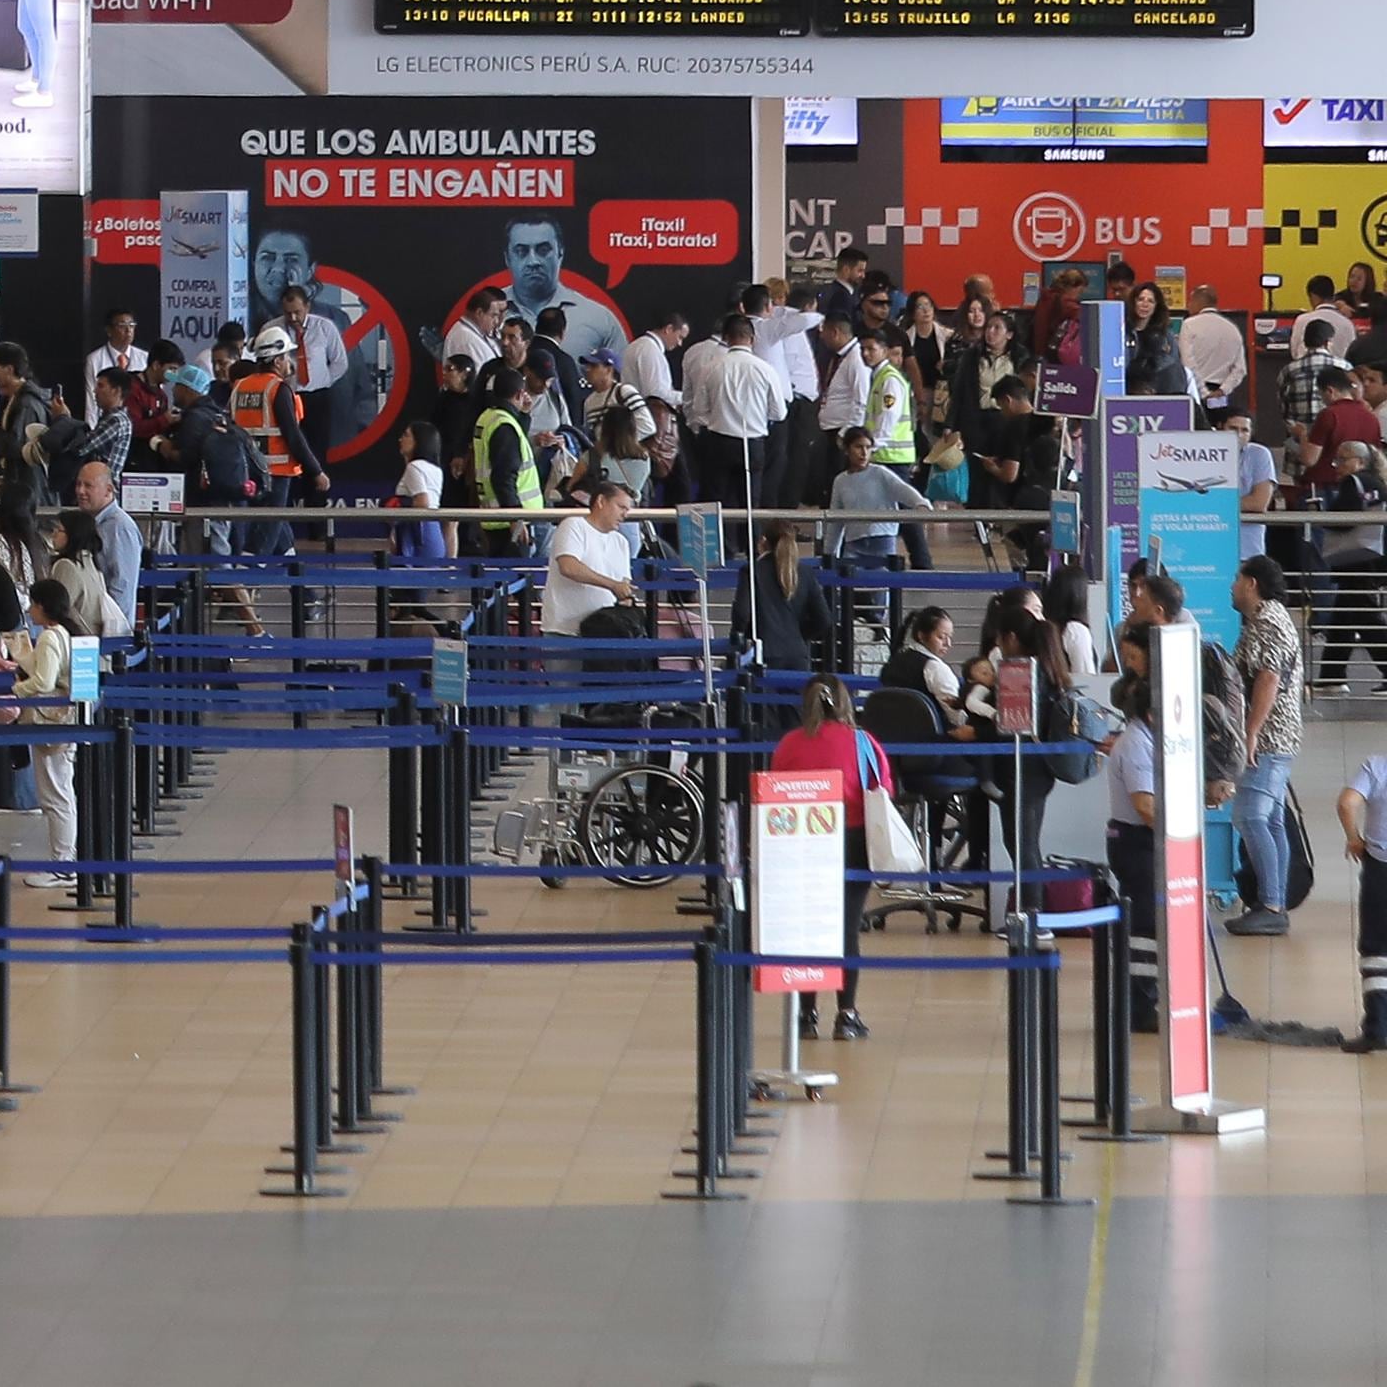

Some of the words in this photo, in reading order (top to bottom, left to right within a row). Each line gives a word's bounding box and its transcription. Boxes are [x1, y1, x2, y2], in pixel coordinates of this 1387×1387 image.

[845, 11, 889, 24] 13:55
[898, 12, 971, 24] TRUJILLO
[997, 12, 1016, 24] LA
[1034, 12, 1070, 24] 2136
[1134, 12, 1216, 24] CANCELADO
[377, 57, 399, 73] LG
[405, 56, 535, 73] ELECTRONICS
[541, 52, 590, 73] PERÚ
[597, 56, 628, 74] S.A.
[638, 56, 681, 74] RUC:
[687, 57, 815, 74] 20375755344
[1002, 97, 1091, 108] AIRPORT
[1322, 99, 1384, 121] TAXI
[1145, 109, 1185, 121] LIMA
[1033, 126, 1060, 137] BUS
[240, 129, 305, 155] QUE
[317, 129, 376, 155] LOS
[384, 129, 596, 155] AMBULANTES
[1043, 149, 1107, 161] SAMSUNG
[272, 169, 329, 198] NO
[339, 169, 376, 198] TE
[389, 162, 563, 198] ENGAÑEN
[641, 217, 685, 232] ¡Taxi!
[1095, 217, 1162, 245] BUS
[609, 233, 653, 249] ¡Taxi,
[657, 232, 717, 249] barato!
[171, 279, 217, 293] COMPRA
[166, 296, 181, 309] TU
[182, 296, 222, 310] PASAJE
[169, 311, 219, 343] AQUÍ
[1043, 381, 1077, 395] Salida
[1149, 443, 1229, 462] JetSMART
